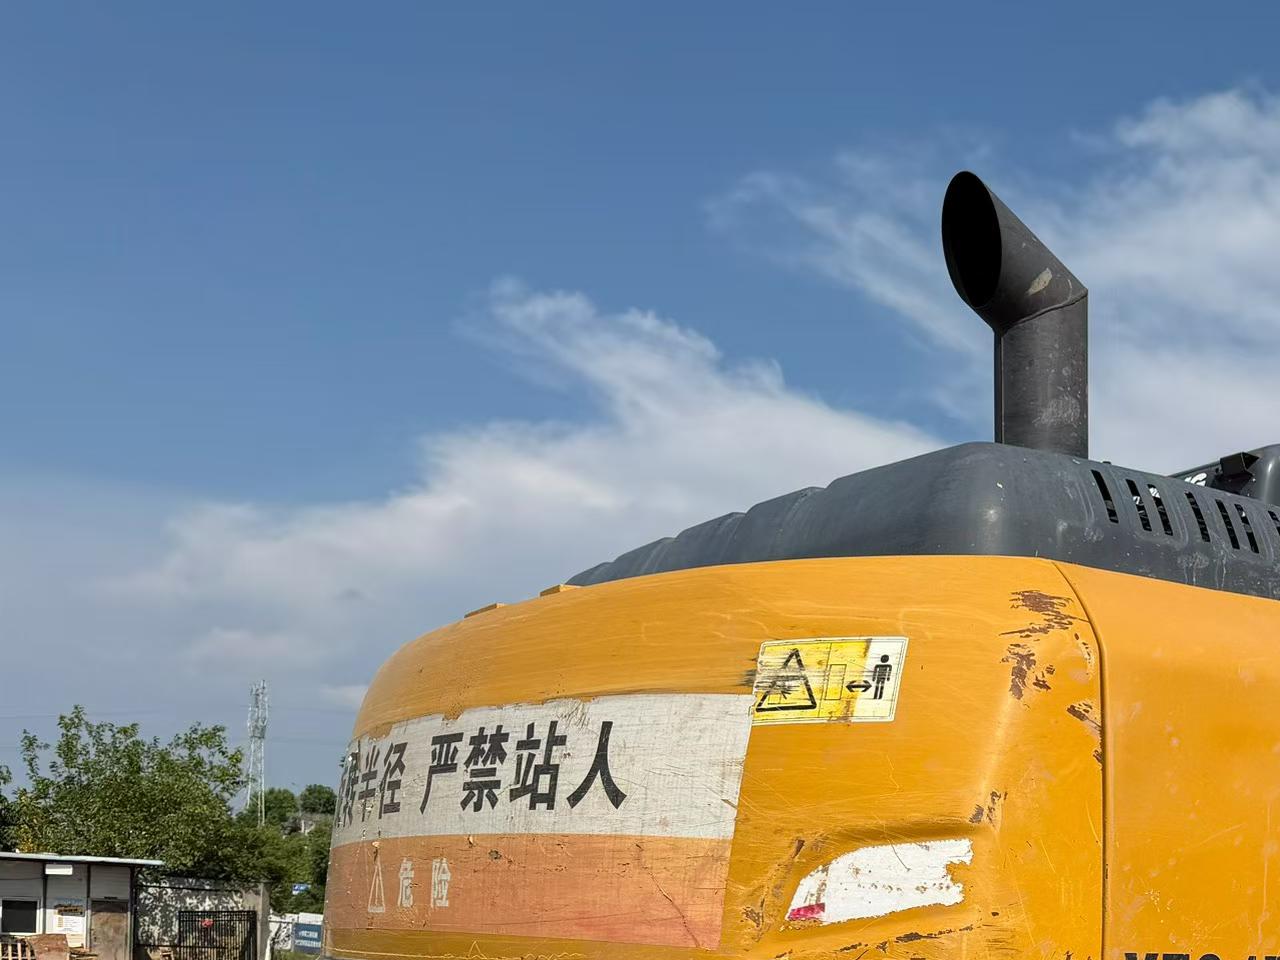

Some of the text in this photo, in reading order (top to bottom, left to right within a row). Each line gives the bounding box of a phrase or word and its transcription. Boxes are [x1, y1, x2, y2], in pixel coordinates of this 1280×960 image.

[420, 720, 627, 815] 严禁站人
[398, 857, 451, 908] 危险
